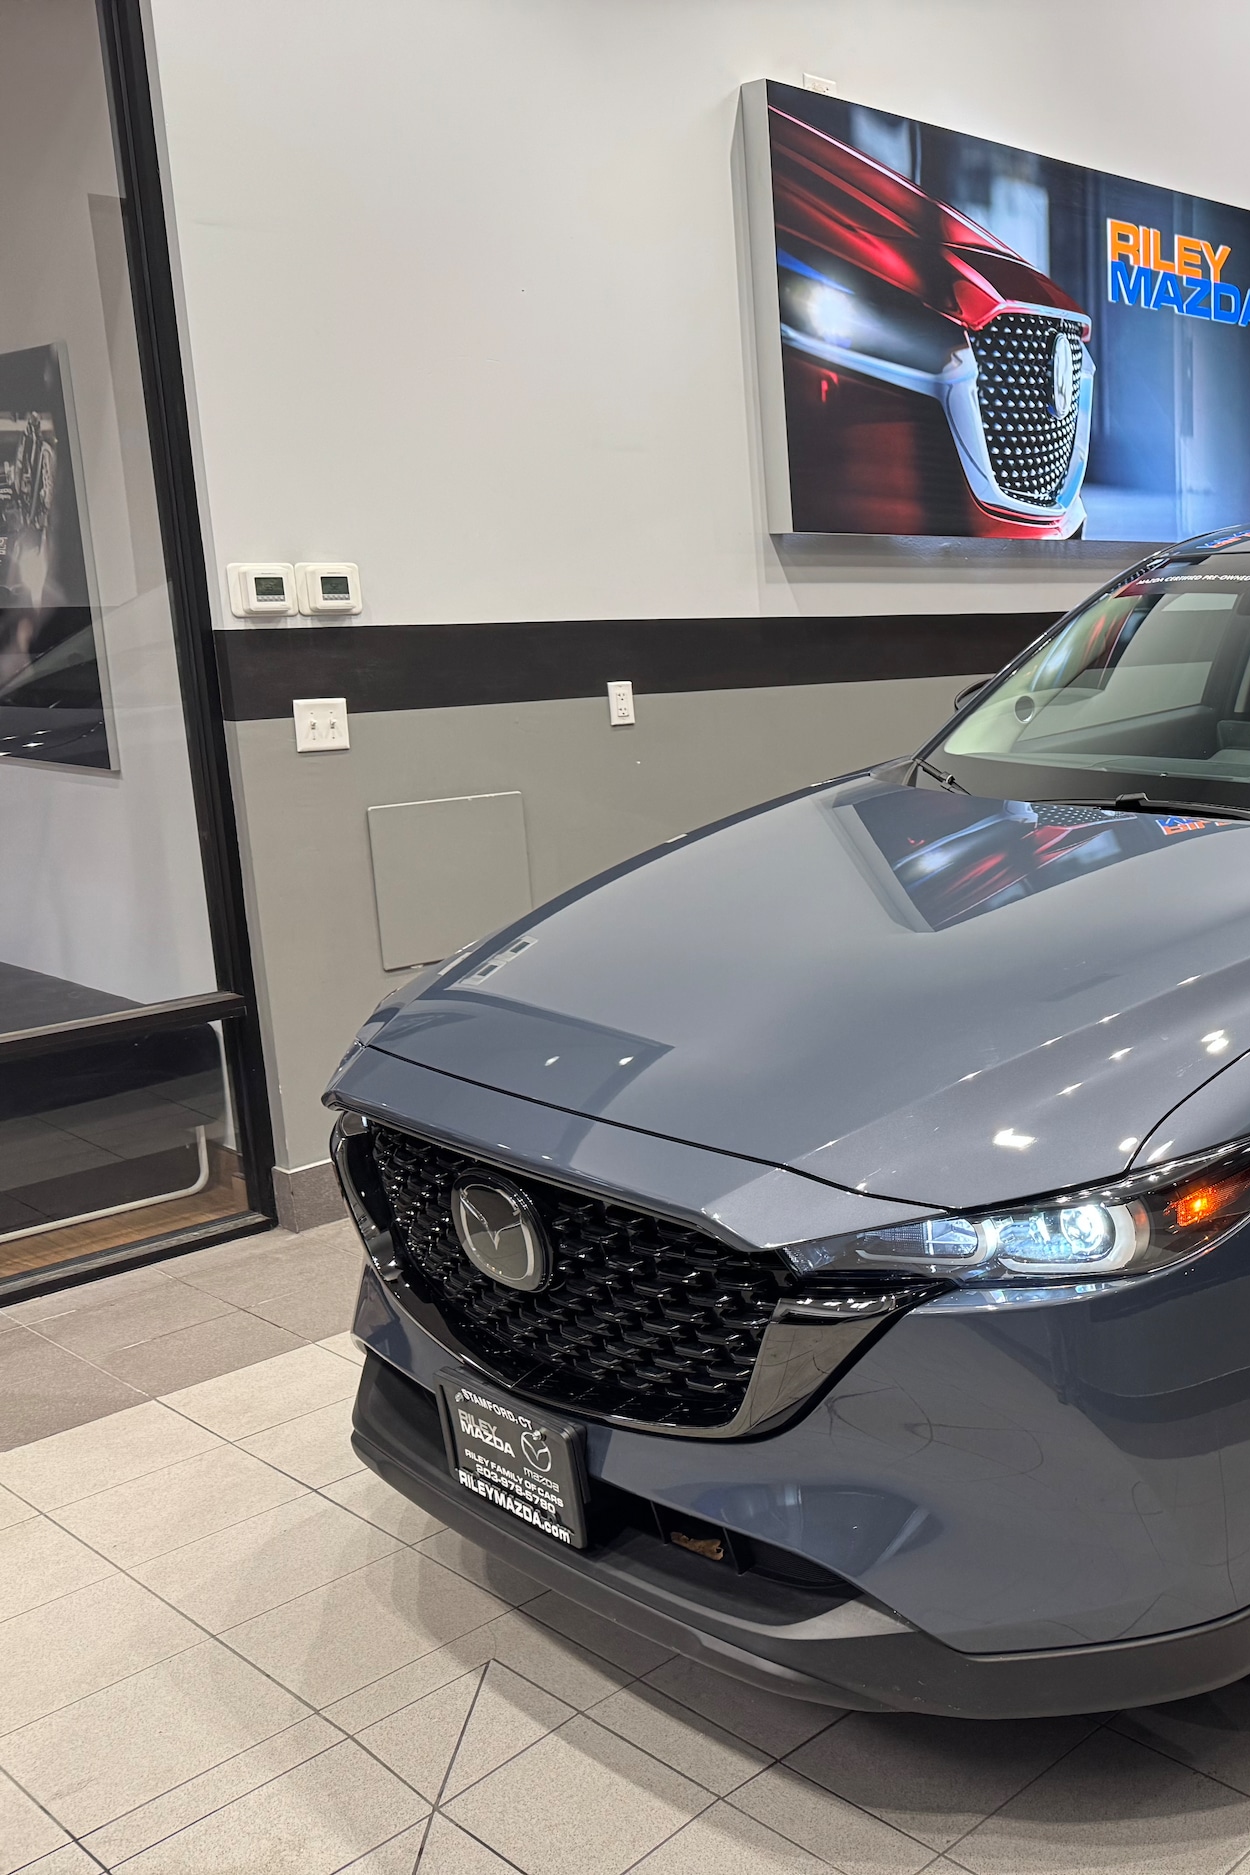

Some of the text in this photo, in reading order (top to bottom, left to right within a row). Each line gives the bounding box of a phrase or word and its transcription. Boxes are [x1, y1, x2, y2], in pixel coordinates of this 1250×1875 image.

[1107, 217, 1231, 284] RILEY
[1136, 577, 1164, 585] MAZDA
[458, 1408, 497, 1436] RILEY
[461, 1388, 533, 1431] STAMFORD, CT
[460, 1420, 516, 1458] MAZDA
[464, 1448, 564, 1508] RILEY FAMILY OF CARS
[475, 1463, 556, 1514] 203-978-5780
[458, 1470, 571, 1544] RILEYMAZDA.com
